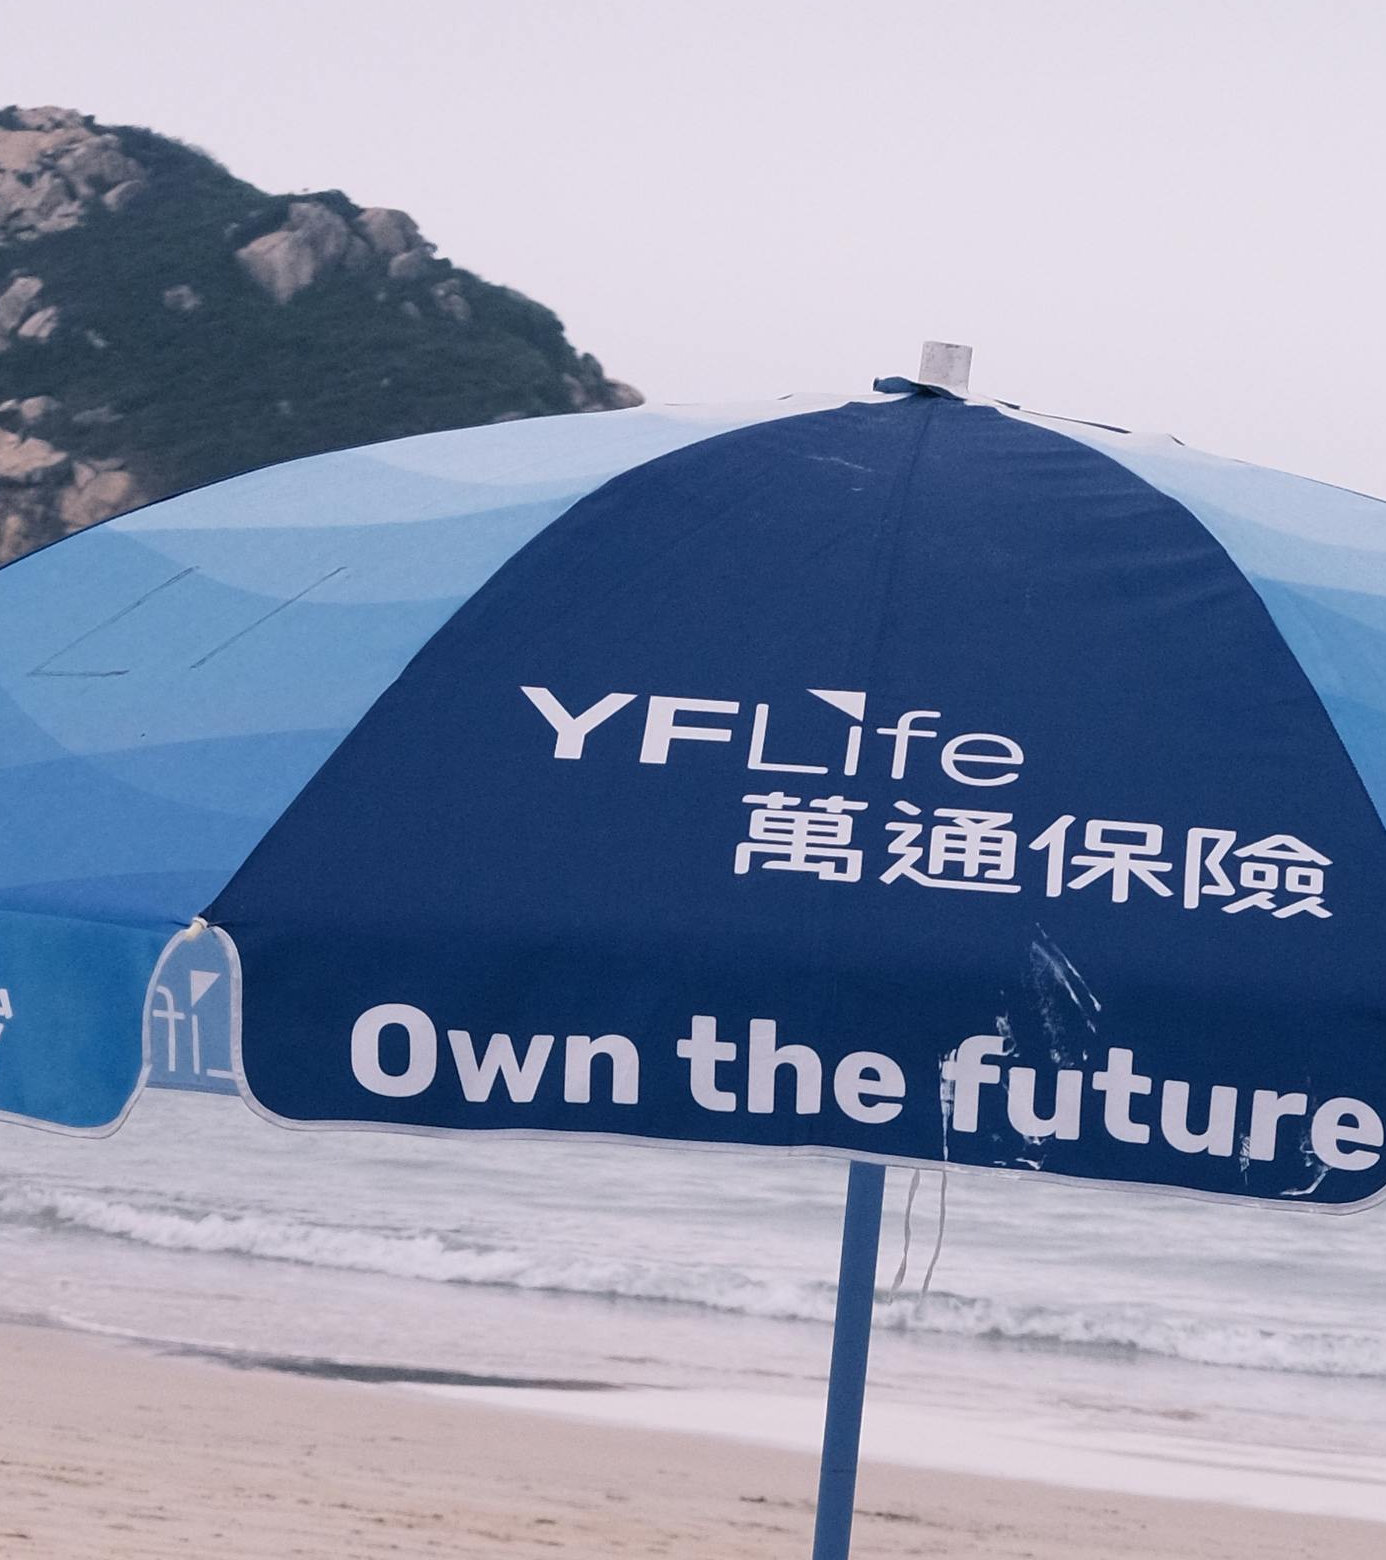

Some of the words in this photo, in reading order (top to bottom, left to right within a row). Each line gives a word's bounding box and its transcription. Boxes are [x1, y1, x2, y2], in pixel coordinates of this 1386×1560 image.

[519, 684, 1026, 788] YFLife
[733, 790, 1334, 920] 萬通保險
[349, 1002, 641, 1106] Own
[675, 1014, 907, 1125] the
[938, 1034, 1385, 1172] future
